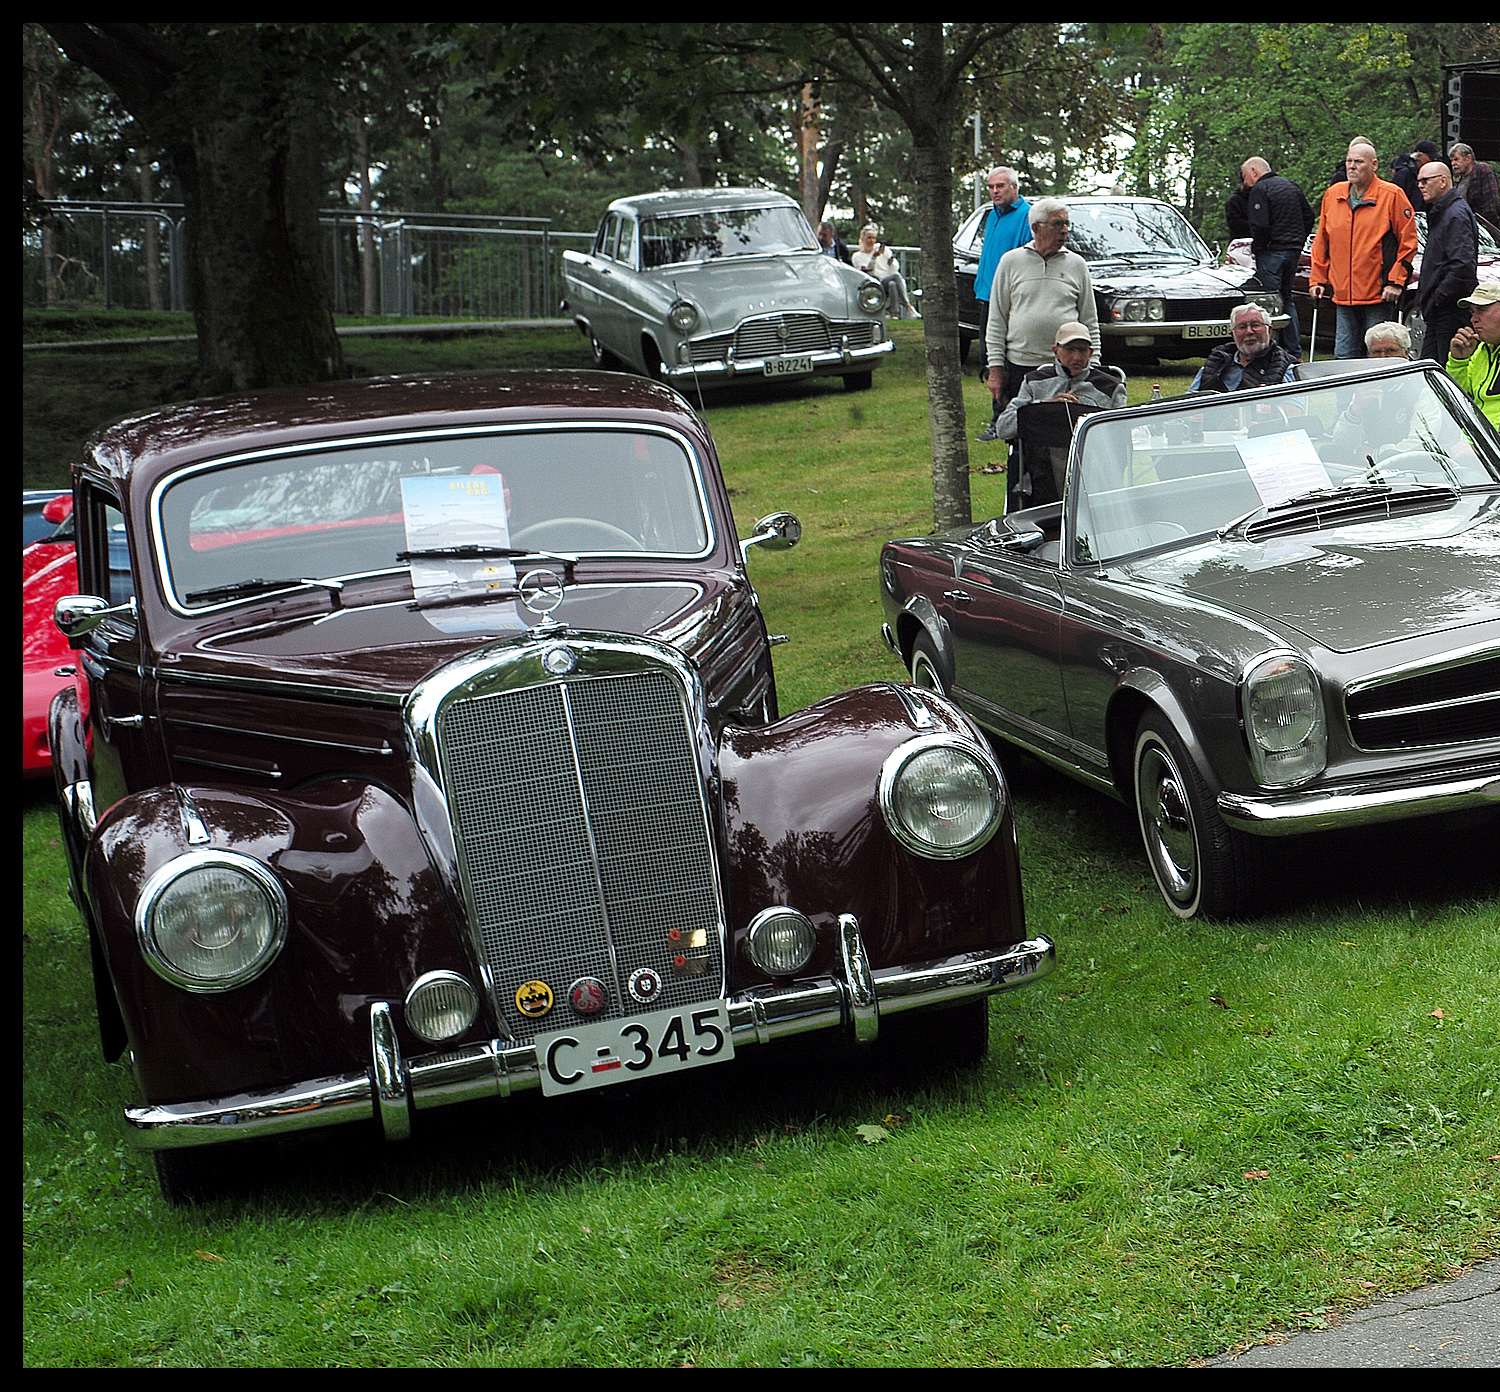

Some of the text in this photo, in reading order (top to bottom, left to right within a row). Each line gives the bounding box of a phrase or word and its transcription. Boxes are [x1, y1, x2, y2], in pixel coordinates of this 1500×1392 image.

[1188, 326, 1203, 337] BL
[765, 358, 812, 374] B-82241
[546, 1008, 725, 1085] C-345
